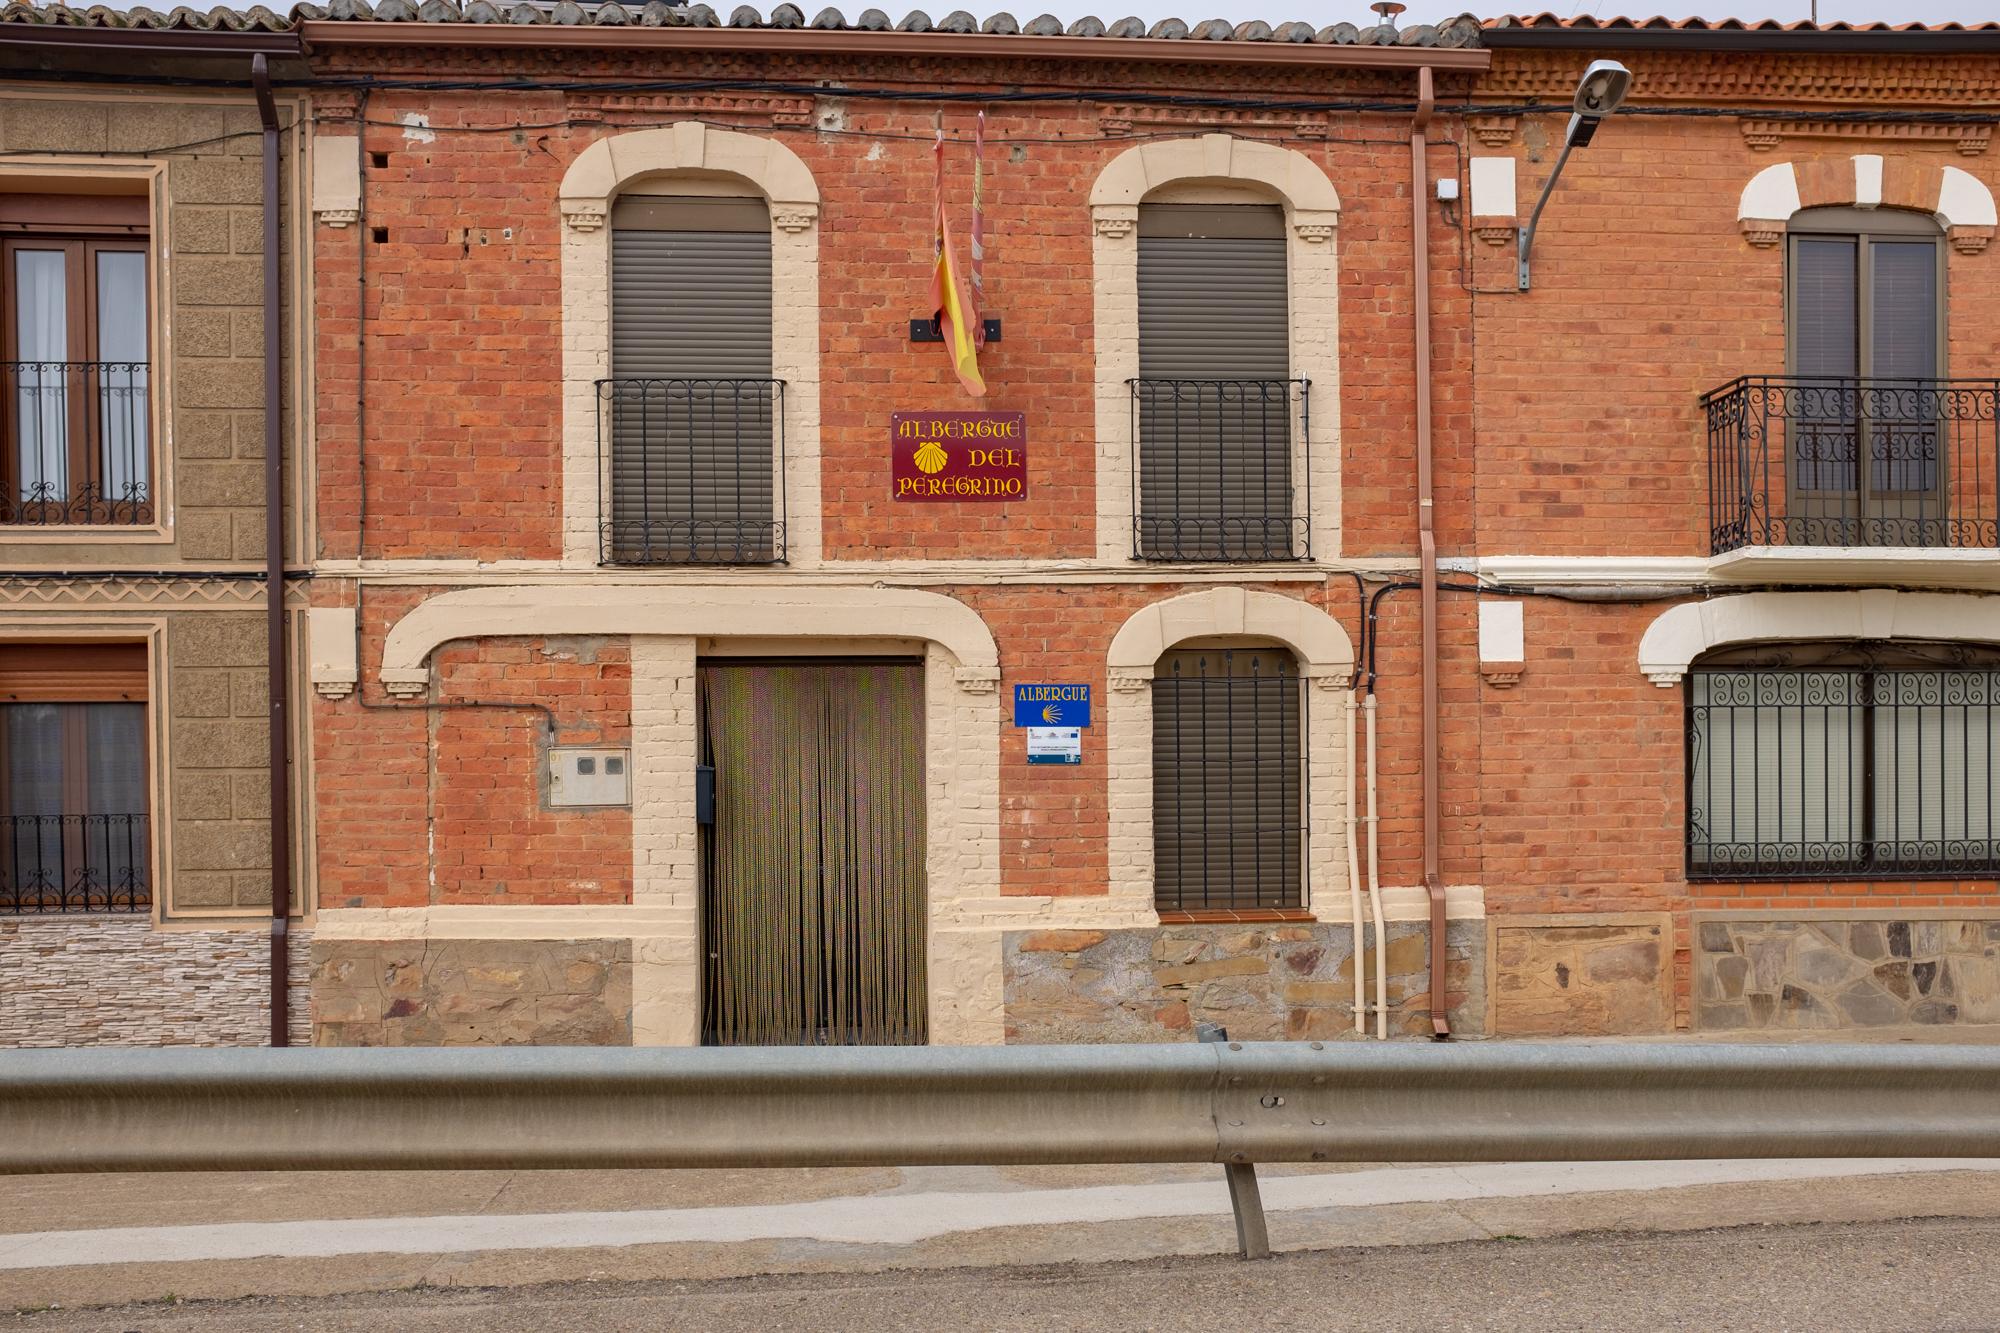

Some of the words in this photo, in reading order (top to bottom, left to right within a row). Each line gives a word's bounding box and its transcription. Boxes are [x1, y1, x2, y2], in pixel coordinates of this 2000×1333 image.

[897, 418, 1021, 439] ALBERGUE
[967, 446, 1021, 468] DEL
[897, 475, 1021, 497] PEREGRINO
[1019, 686, 1088, 701] ALBERGUE
